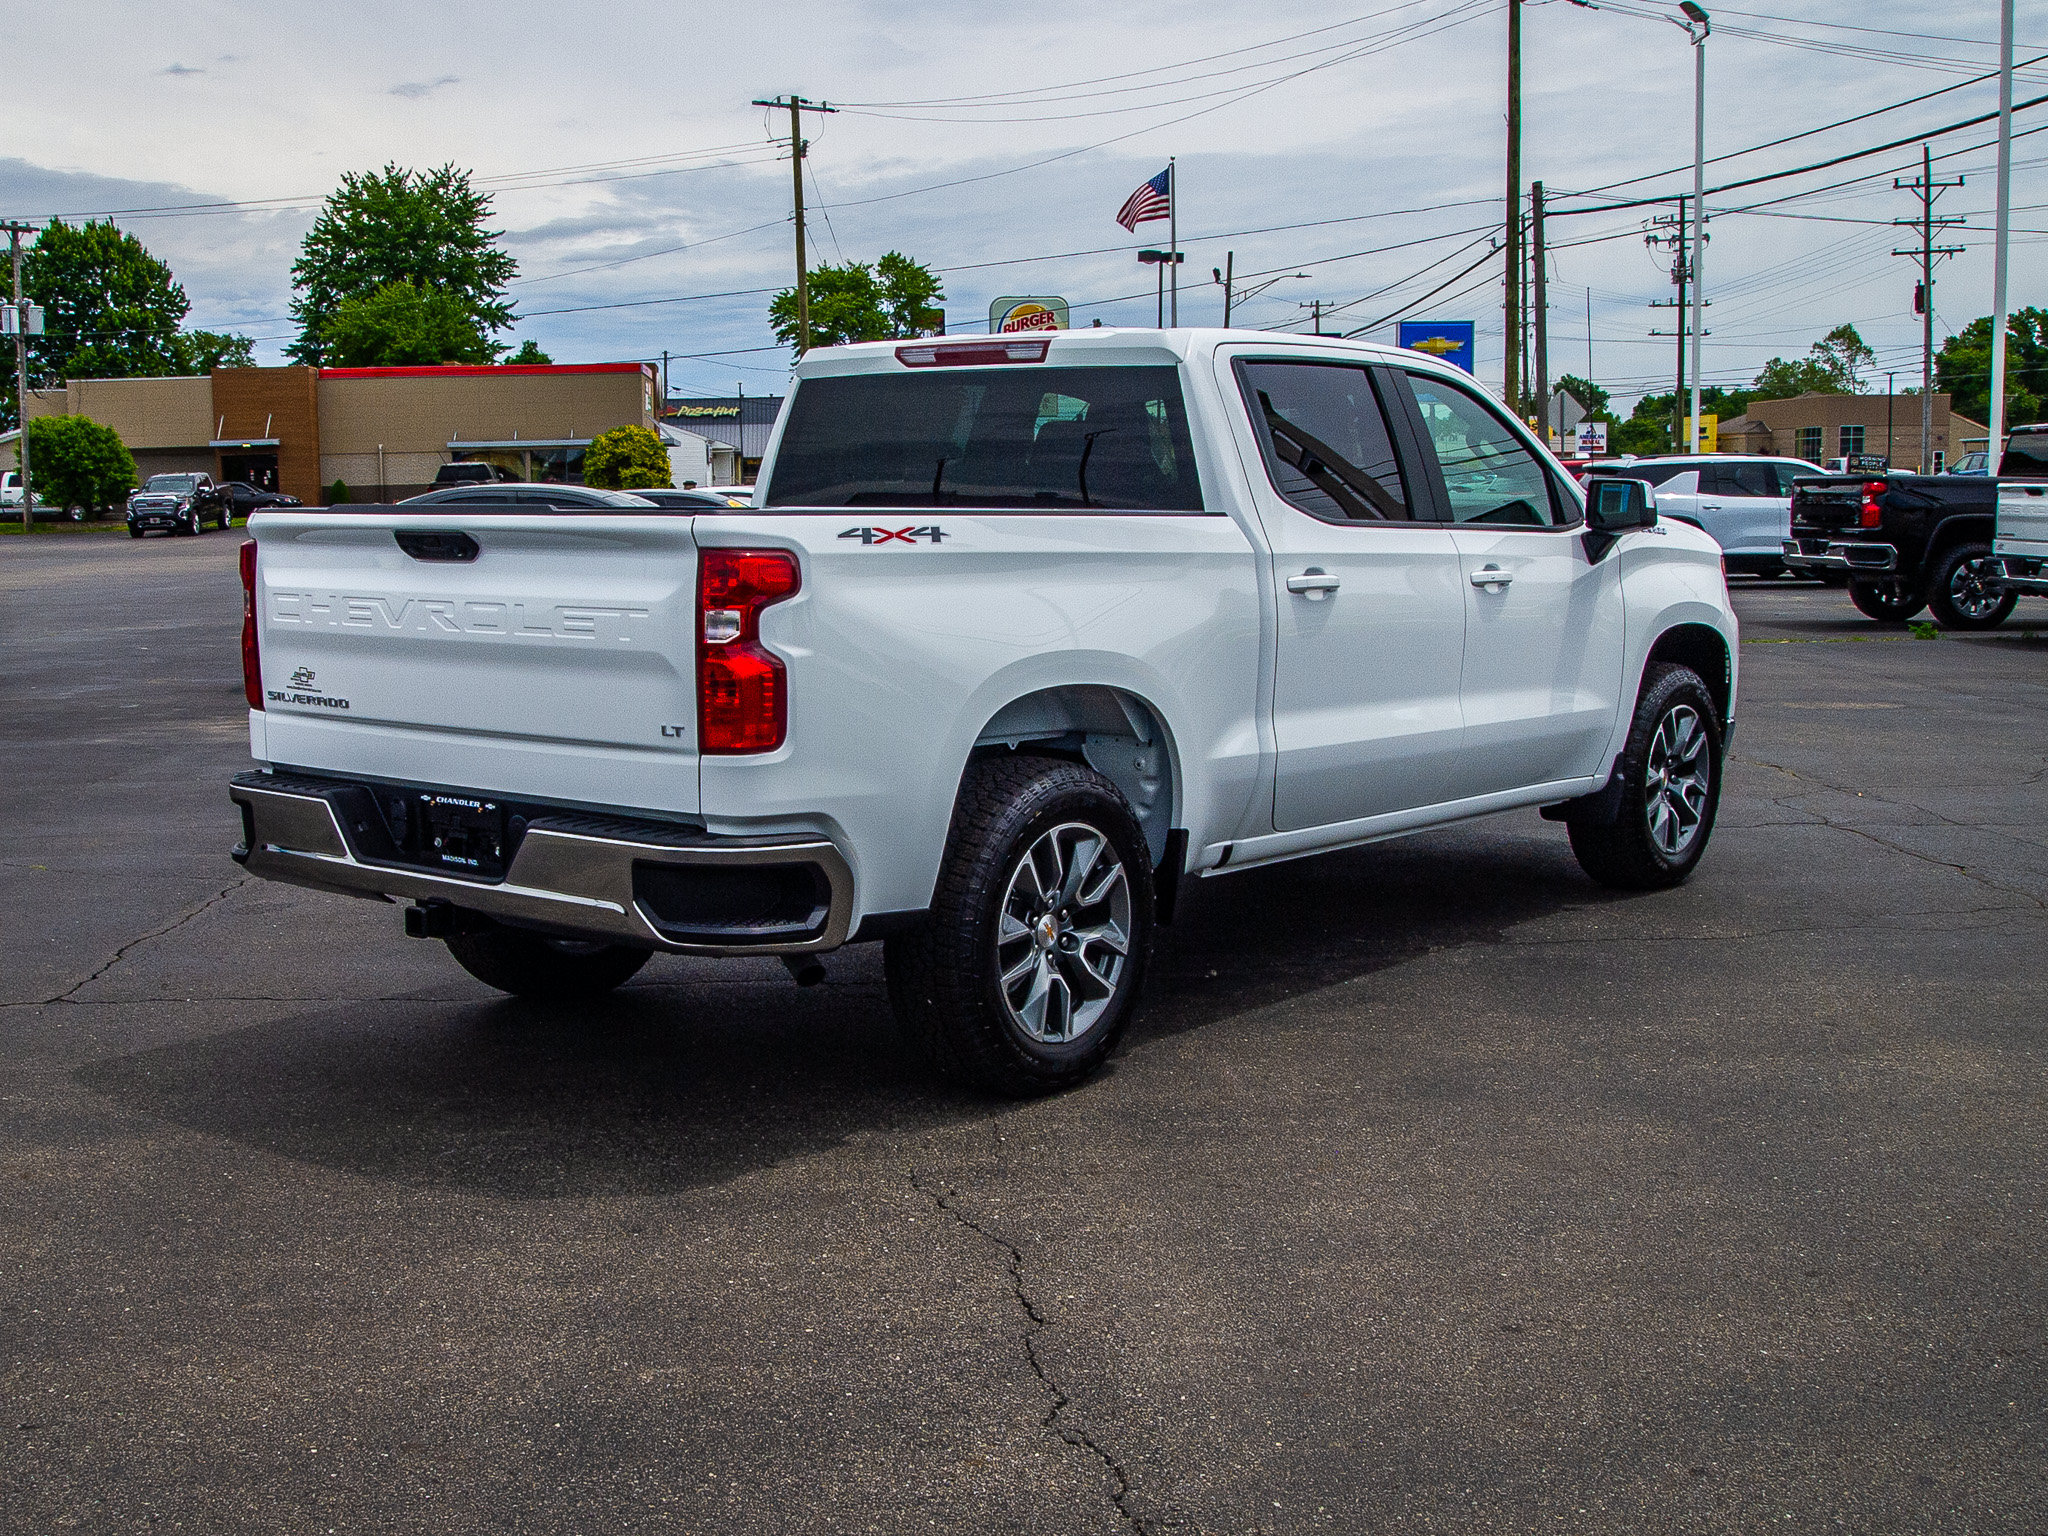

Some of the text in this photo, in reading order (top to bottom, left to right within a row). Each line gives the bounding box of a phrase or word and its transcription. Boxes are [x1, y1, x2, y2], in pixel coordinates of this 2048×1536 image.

[1003, 311, 1055, 333] BURGER
[677, 405, 740, 418] Pizza Hut
[272, 592, 649, 642] CHEVROLET
[268, 690, 350, 709] SILVERADO
[660, 725, 685, 737] LT
[435, 796, 480, 808] CHANDLER
